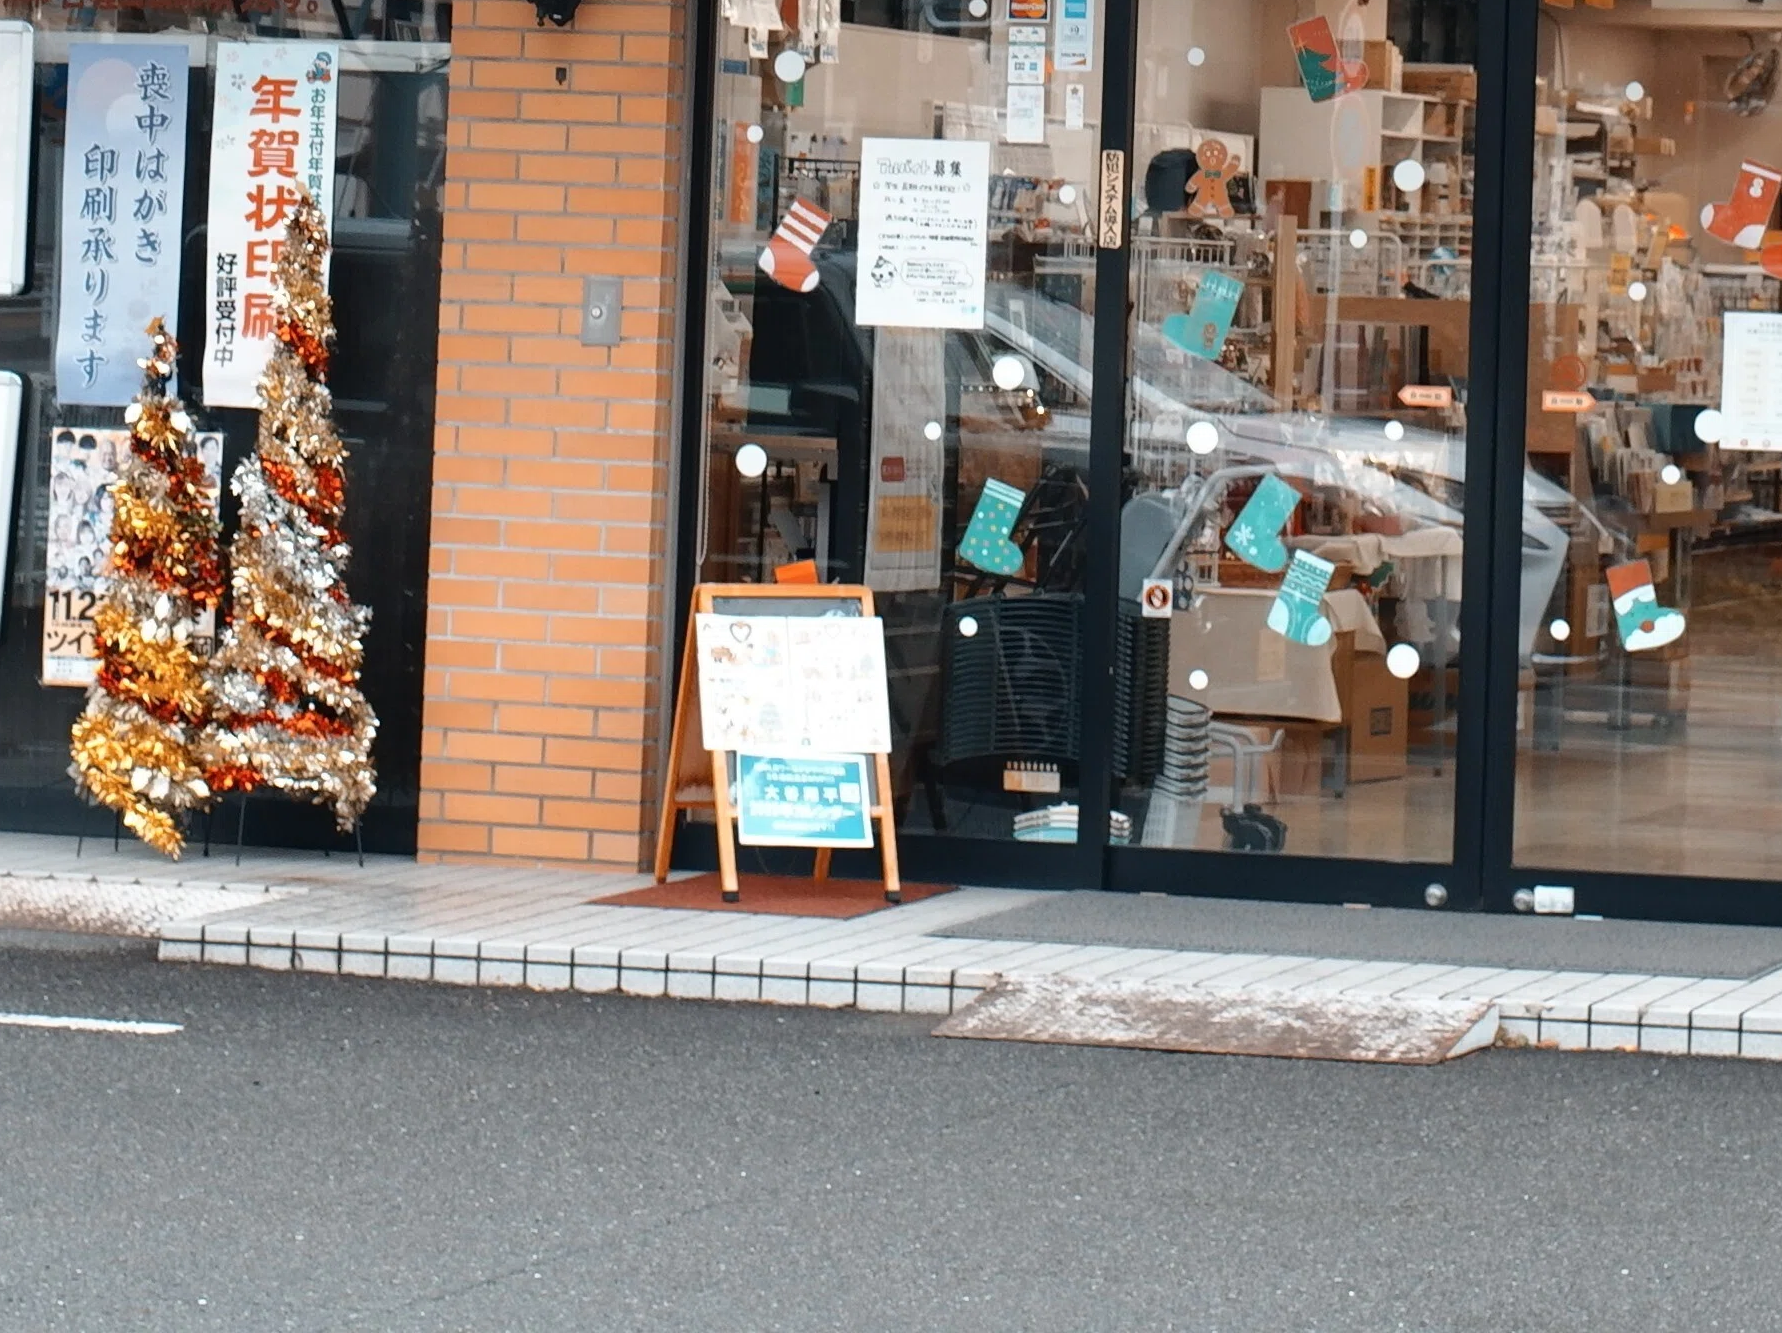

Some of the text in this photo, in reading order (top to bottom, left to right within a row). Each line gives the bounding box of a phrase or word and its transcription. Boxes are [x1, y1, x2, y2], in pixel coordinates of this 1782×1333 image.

[76, 143, 121, 389] 印刷承ります
[132, 61, 171, 267] 喪中はがき
[213, 253, 238, 368] 好評受付中
